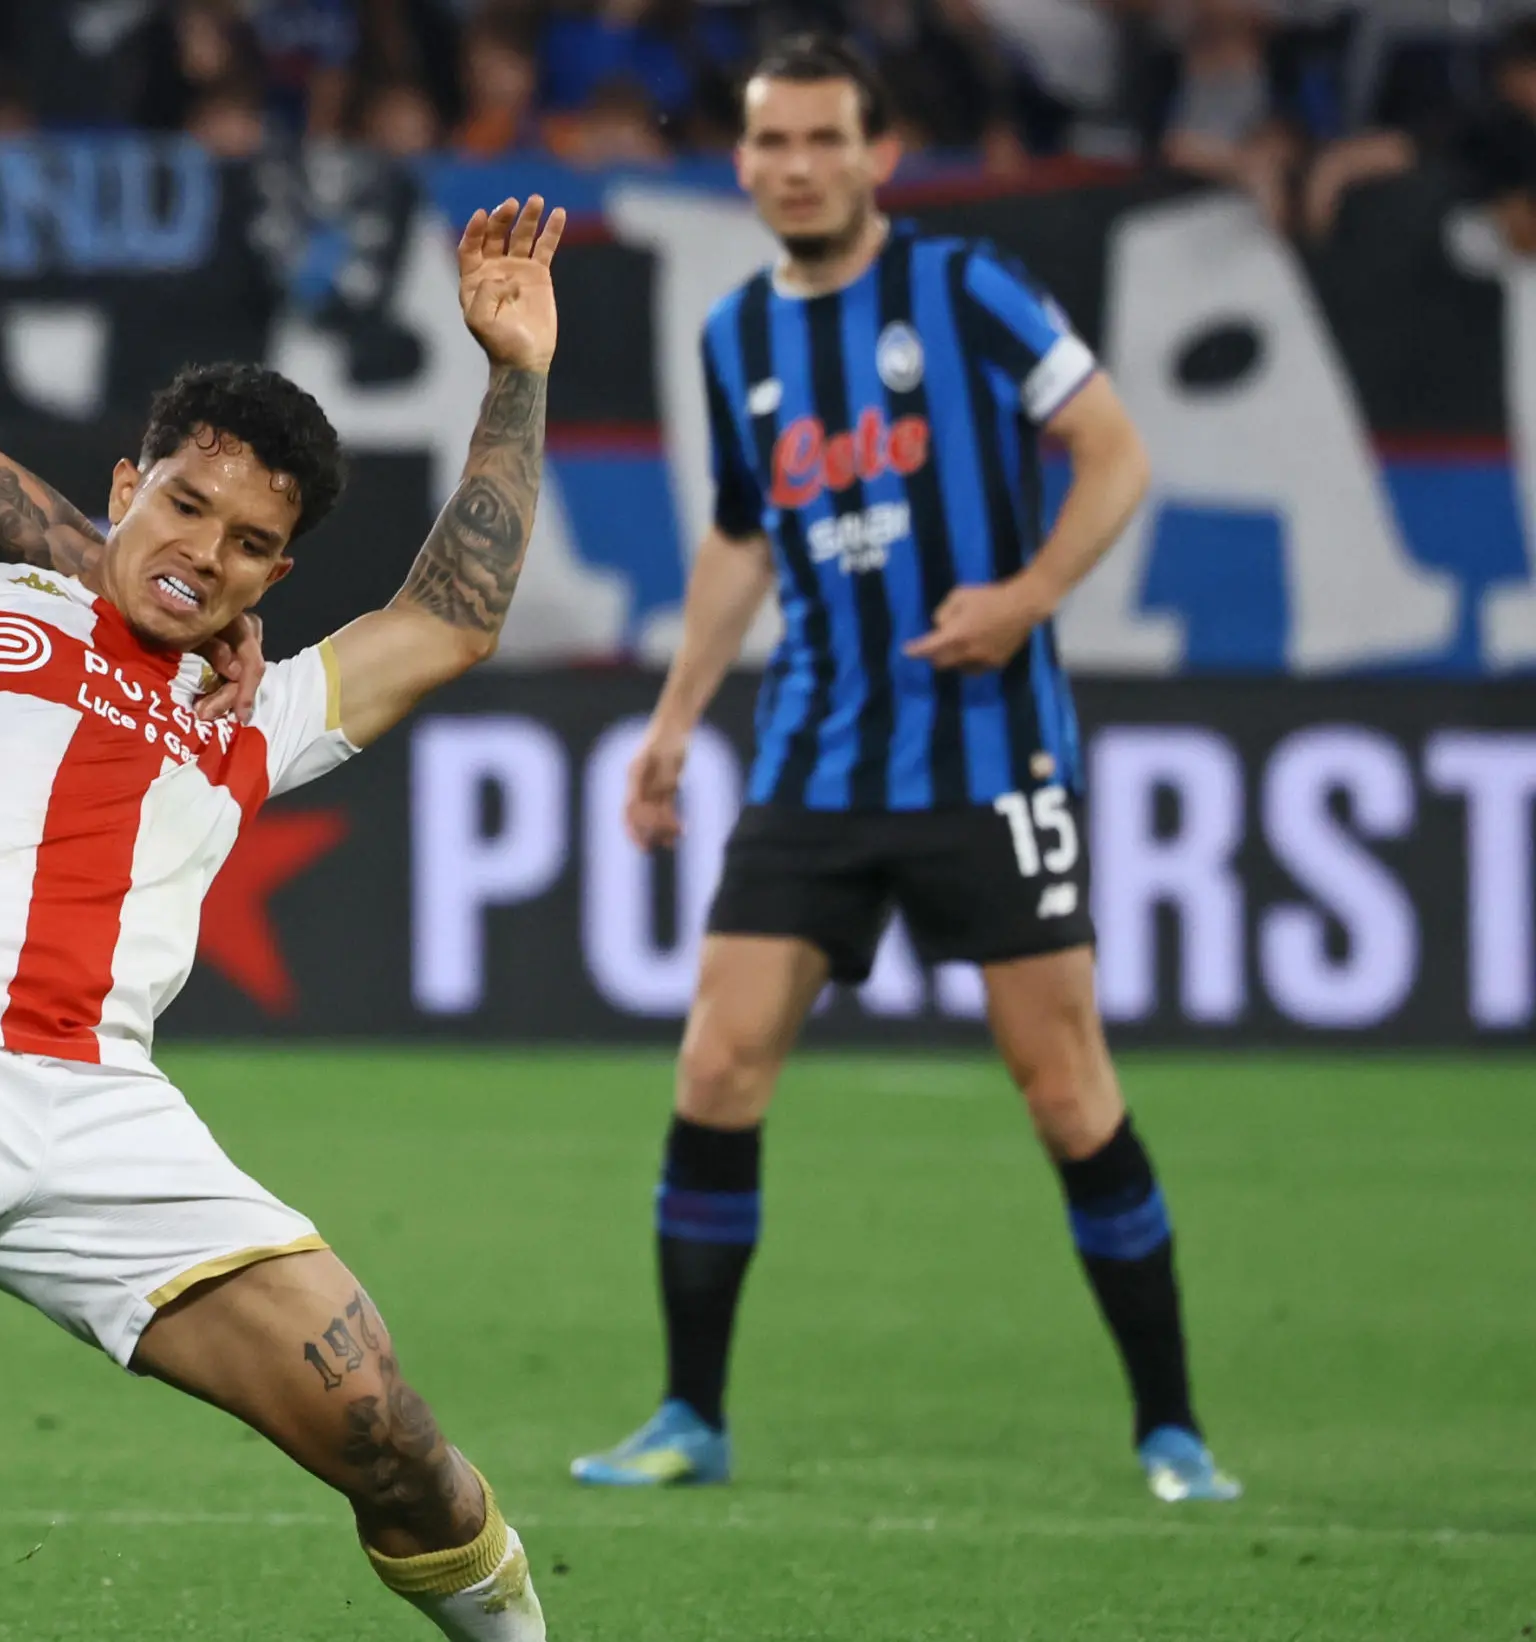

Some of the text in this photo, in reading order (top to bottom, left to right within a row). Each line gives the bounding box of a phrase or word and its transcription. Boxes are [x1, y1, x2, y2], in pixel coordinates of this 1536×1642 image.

[77, 682, 199, 763] Luce e Ga
[993, 784, 1080, 877] 15
